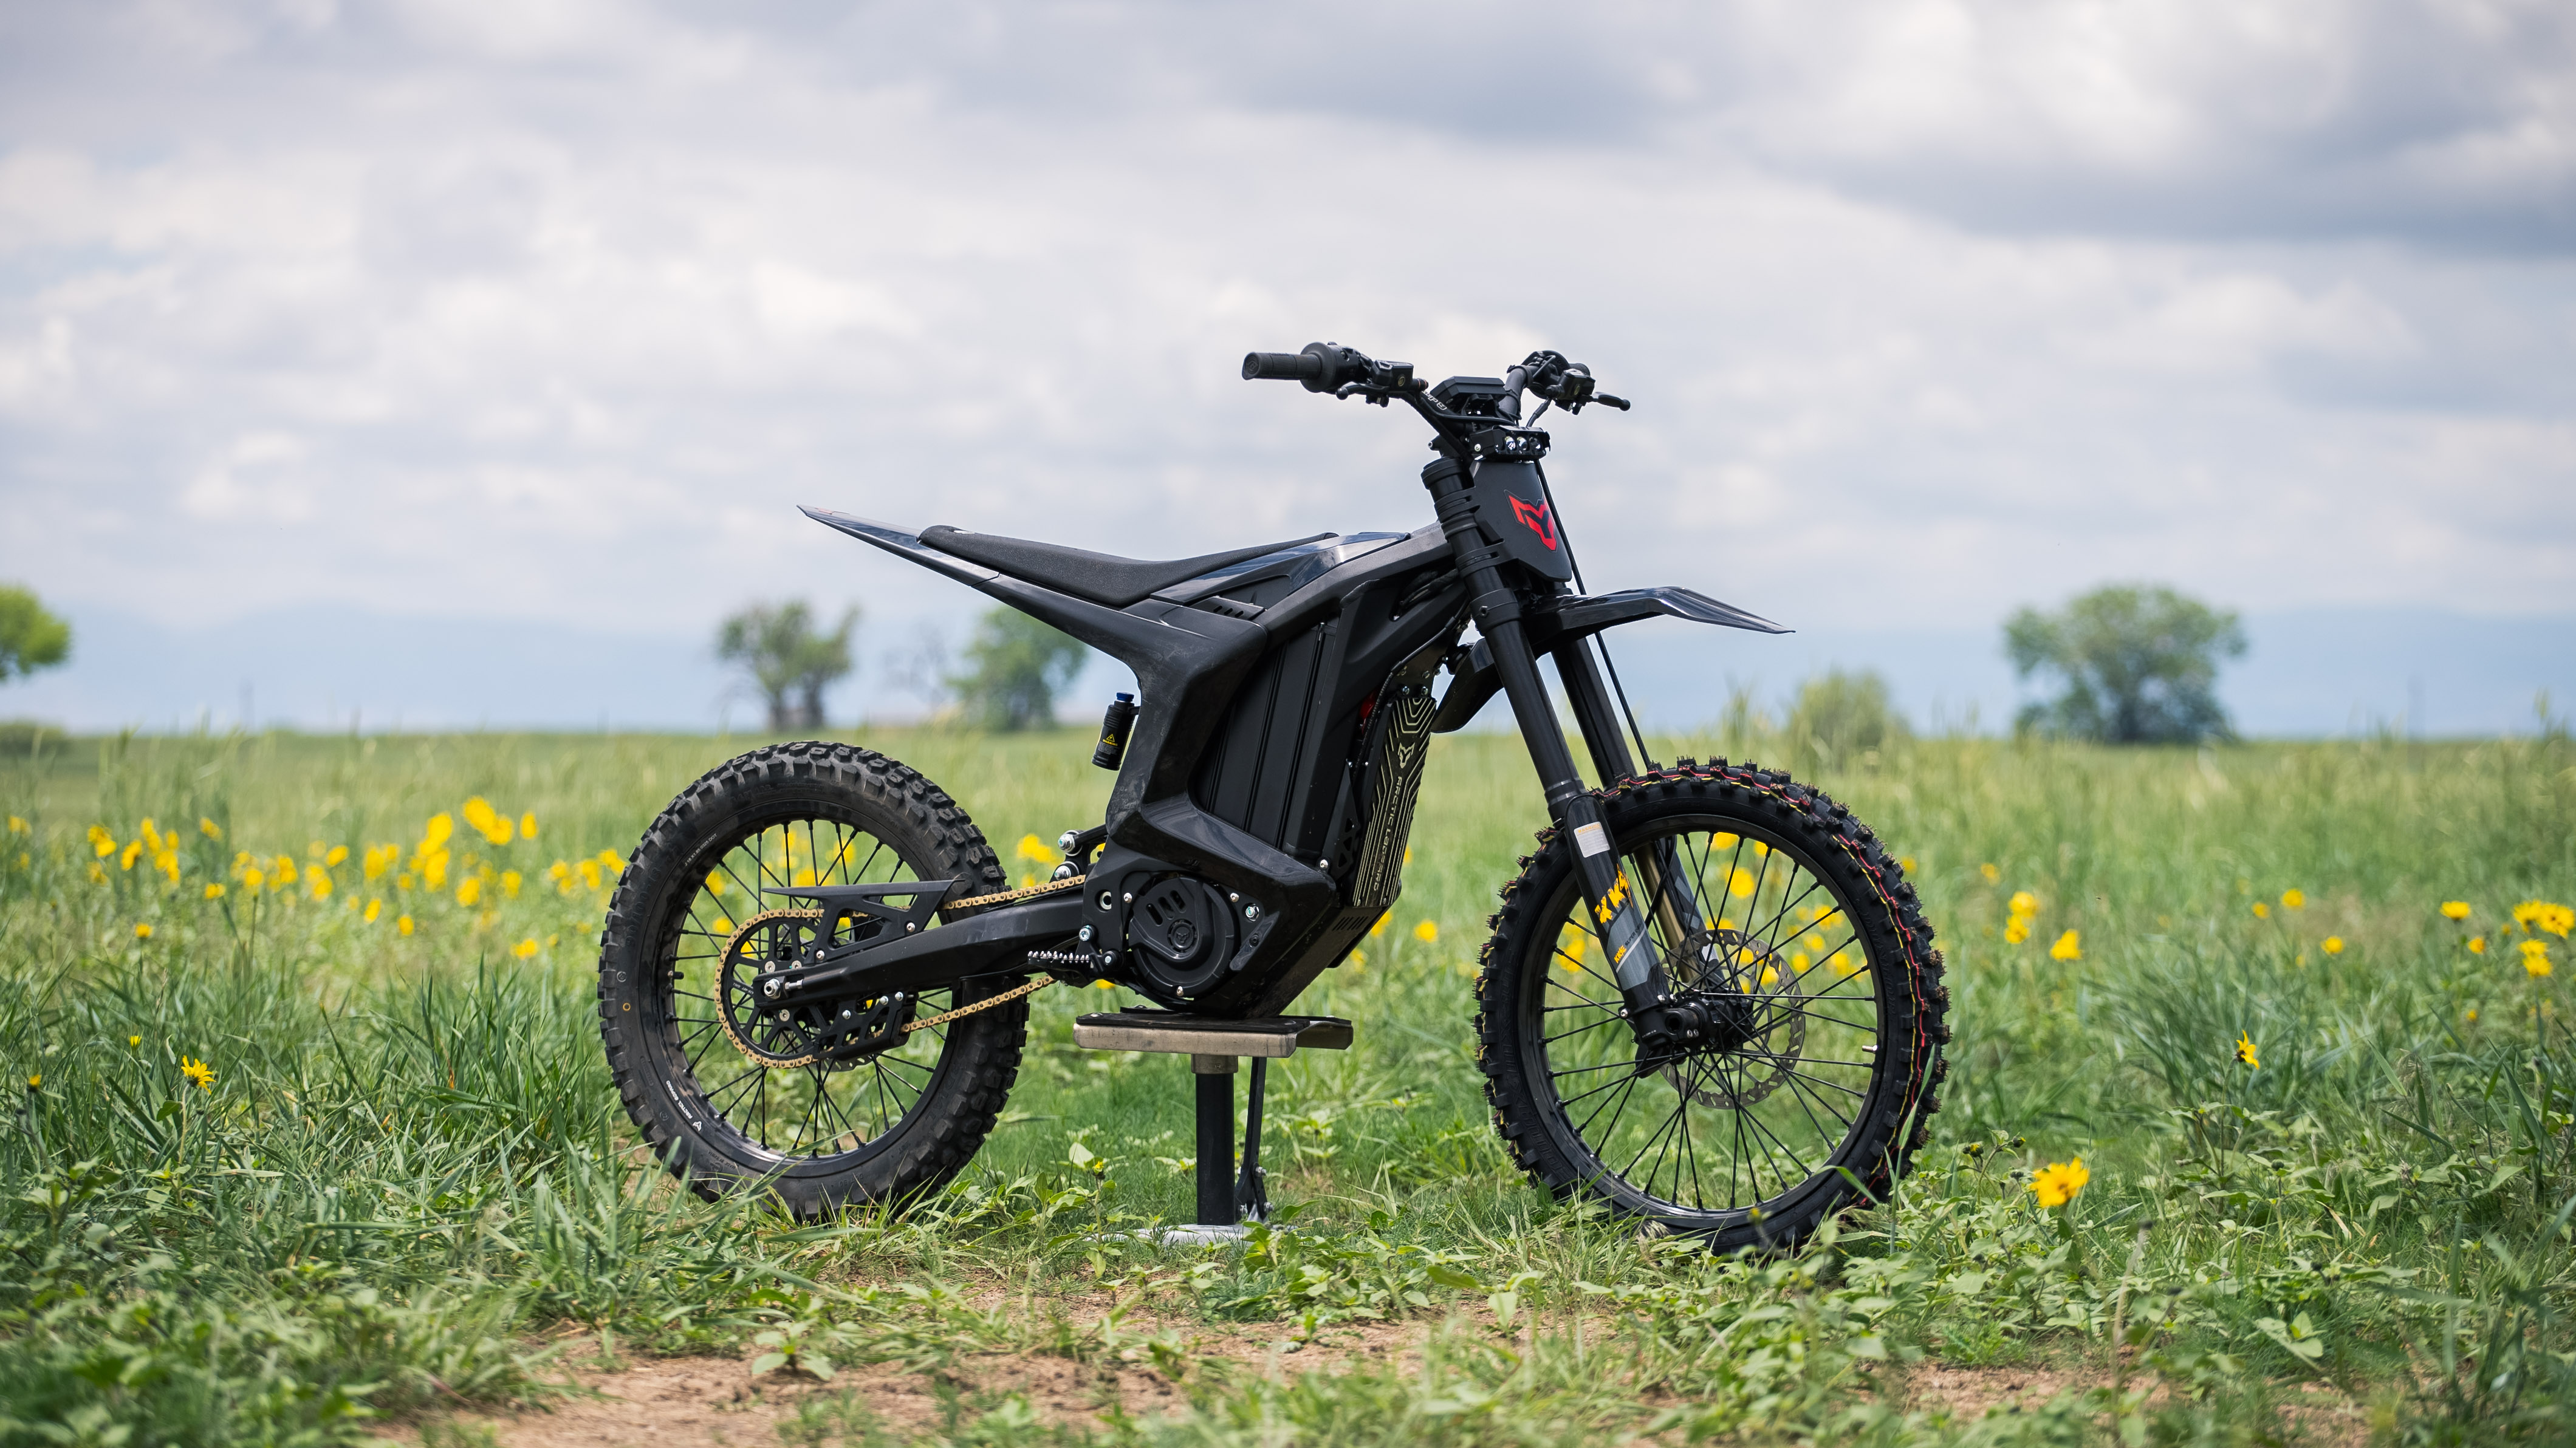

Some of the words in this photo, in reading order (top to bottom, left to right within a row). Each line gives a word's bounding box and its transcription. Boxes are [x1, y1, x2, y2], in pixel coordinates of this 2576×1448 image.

[1387, 776, 1402, 826] ARCTIC
[708, 833, 718, 842] DOT
[1624, 931, 1637, 946] SUPER
